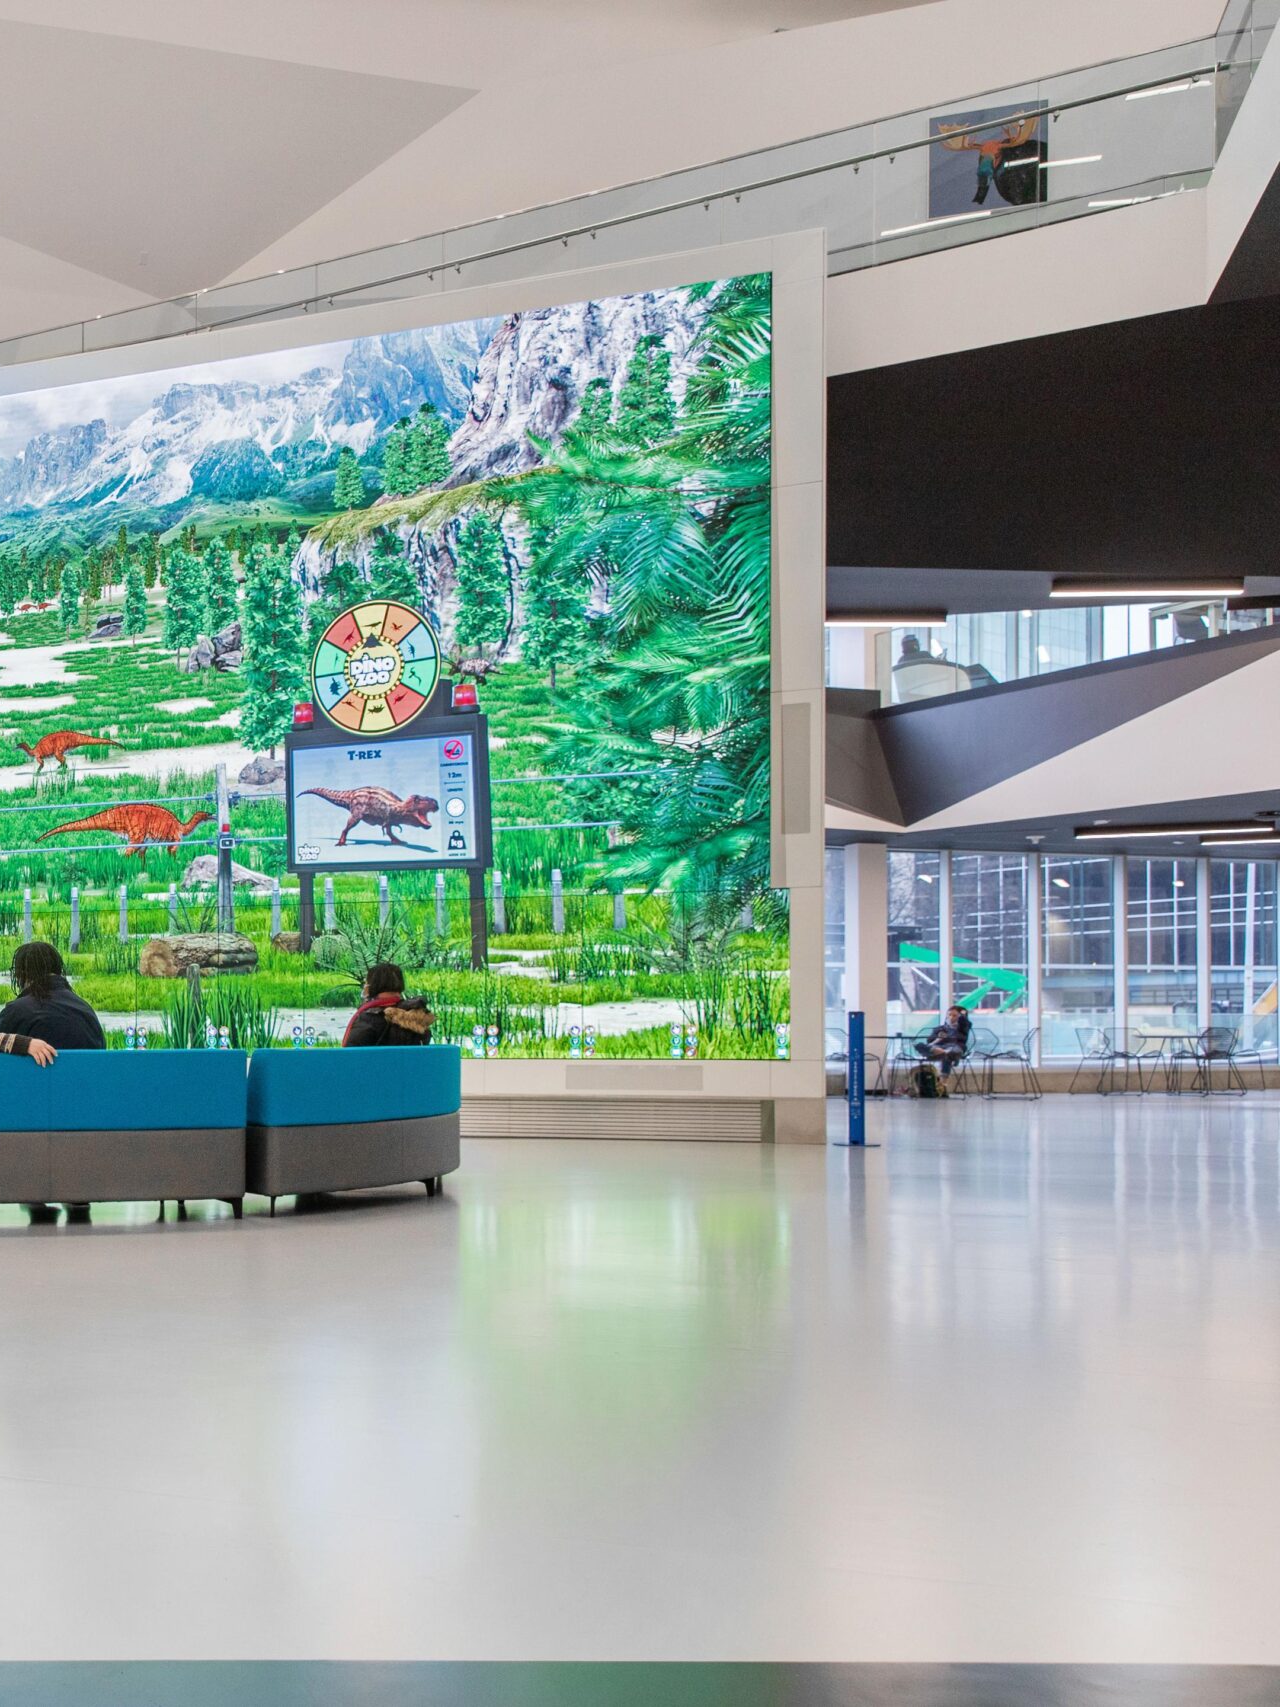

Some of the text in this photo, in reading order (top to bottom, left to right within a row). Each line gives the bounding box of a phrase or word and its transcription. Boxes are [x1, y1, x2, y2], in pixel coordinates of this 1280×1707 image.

[350, 653, 395, 676] DINO
[353, 671, 390, 687] ZOO
[347, 749, 382, 760] T-REX
[450, 838, 464, 848] kg
